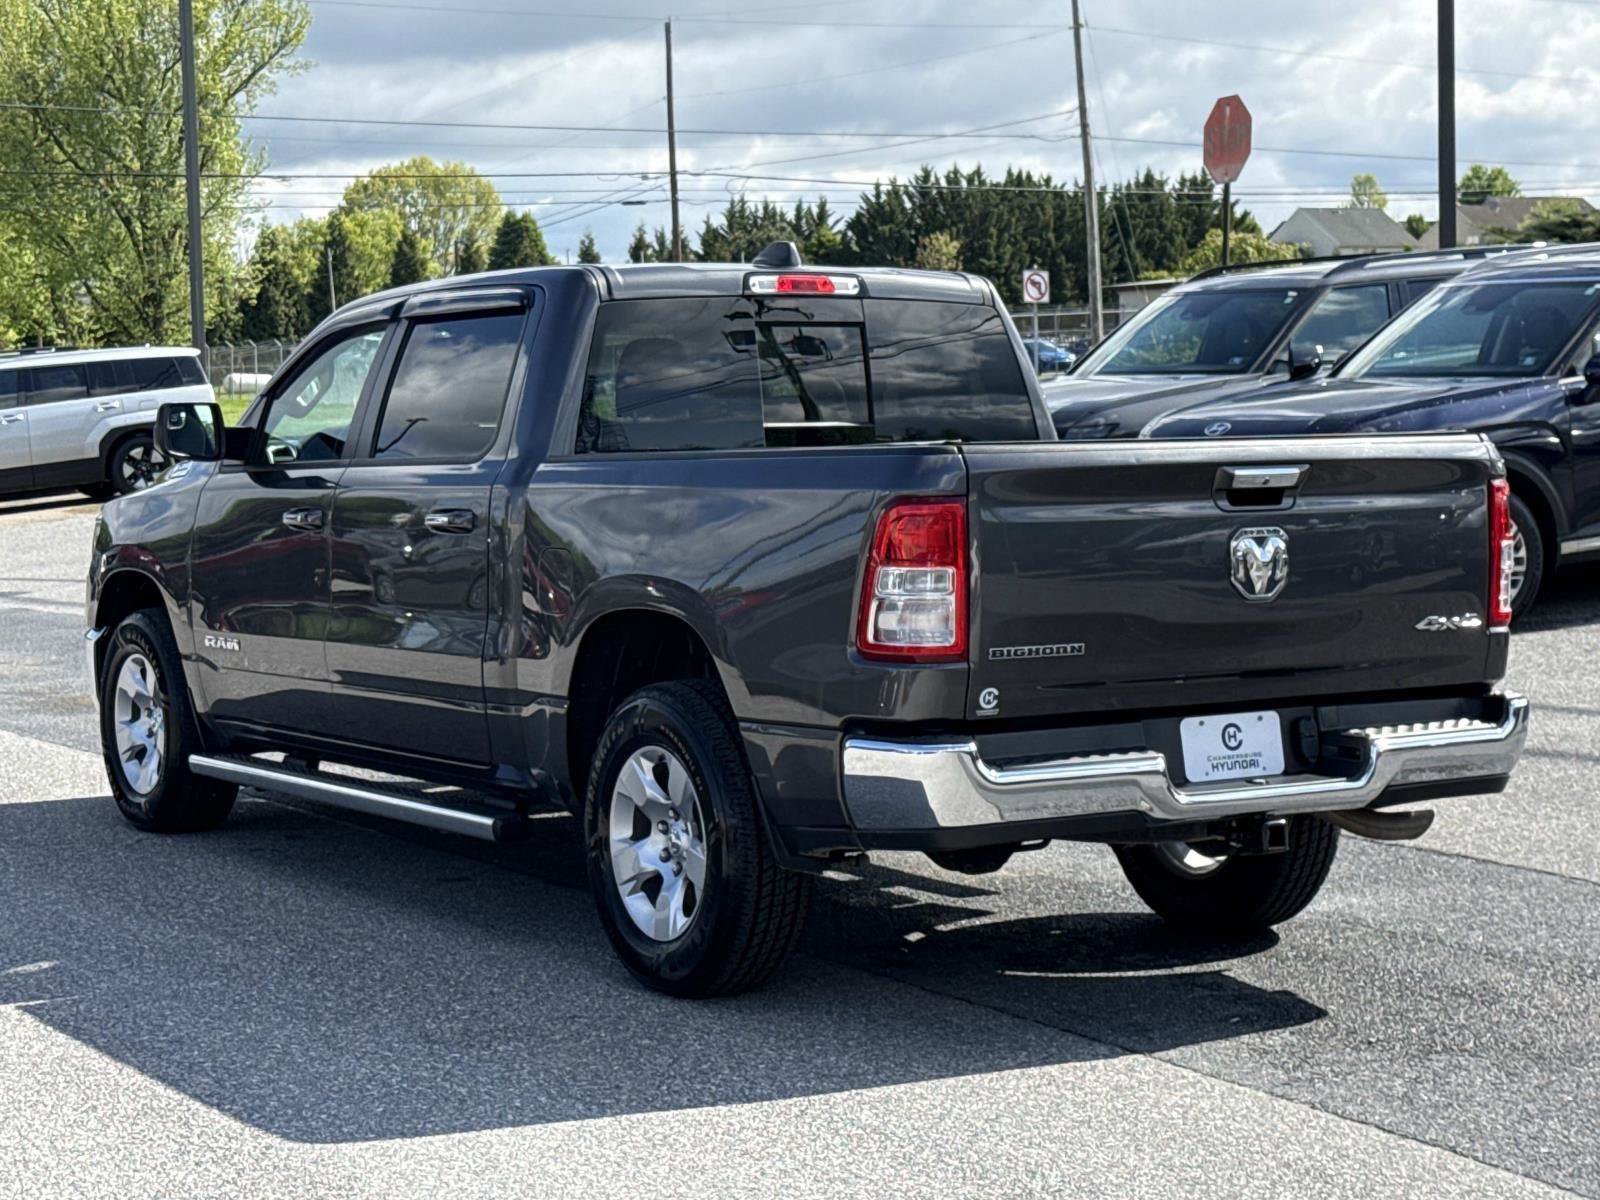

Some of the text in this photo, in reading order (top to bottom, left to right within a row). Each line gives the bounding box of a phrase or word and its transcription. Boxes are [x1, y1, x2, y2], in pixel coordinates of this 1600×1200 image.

[1204, 123, 1250, 160] STOP
[1241, 529, 1281, 538] RAM
[204, 635, 240, 651] RAM
[1211, 758, 1260, 772] HYUNDAI
